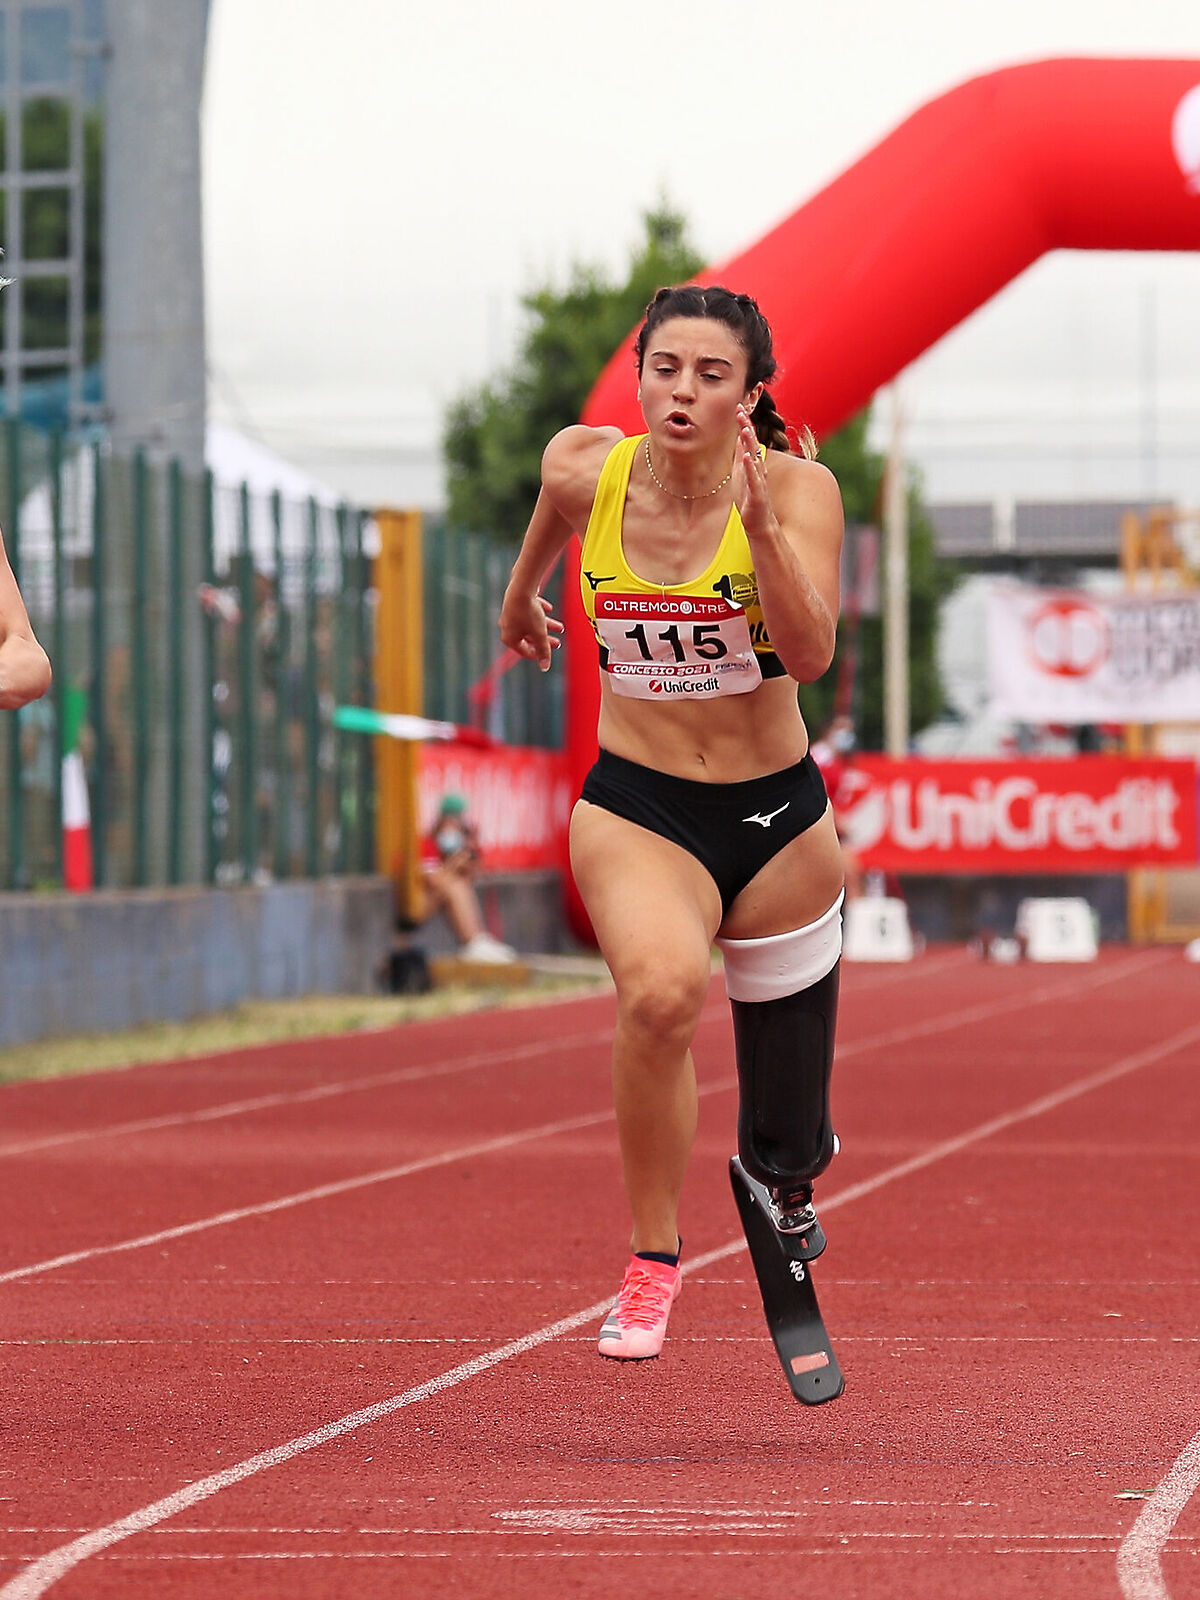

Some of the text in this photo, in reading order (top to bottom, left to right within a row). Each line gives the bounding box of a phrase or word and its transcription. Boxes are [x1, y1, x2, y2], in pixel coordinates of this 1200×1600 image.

[603, 600, 728, 615] OLTREMODOLTRE
[625, 624, 728, 663] 115
[612, 664, 675, 675] CONCESIO
[676, 665, 708, 676] 2021
[663, 678, 720, 693] UniCredit
[891, 776, 1180, 850] UniCredit
